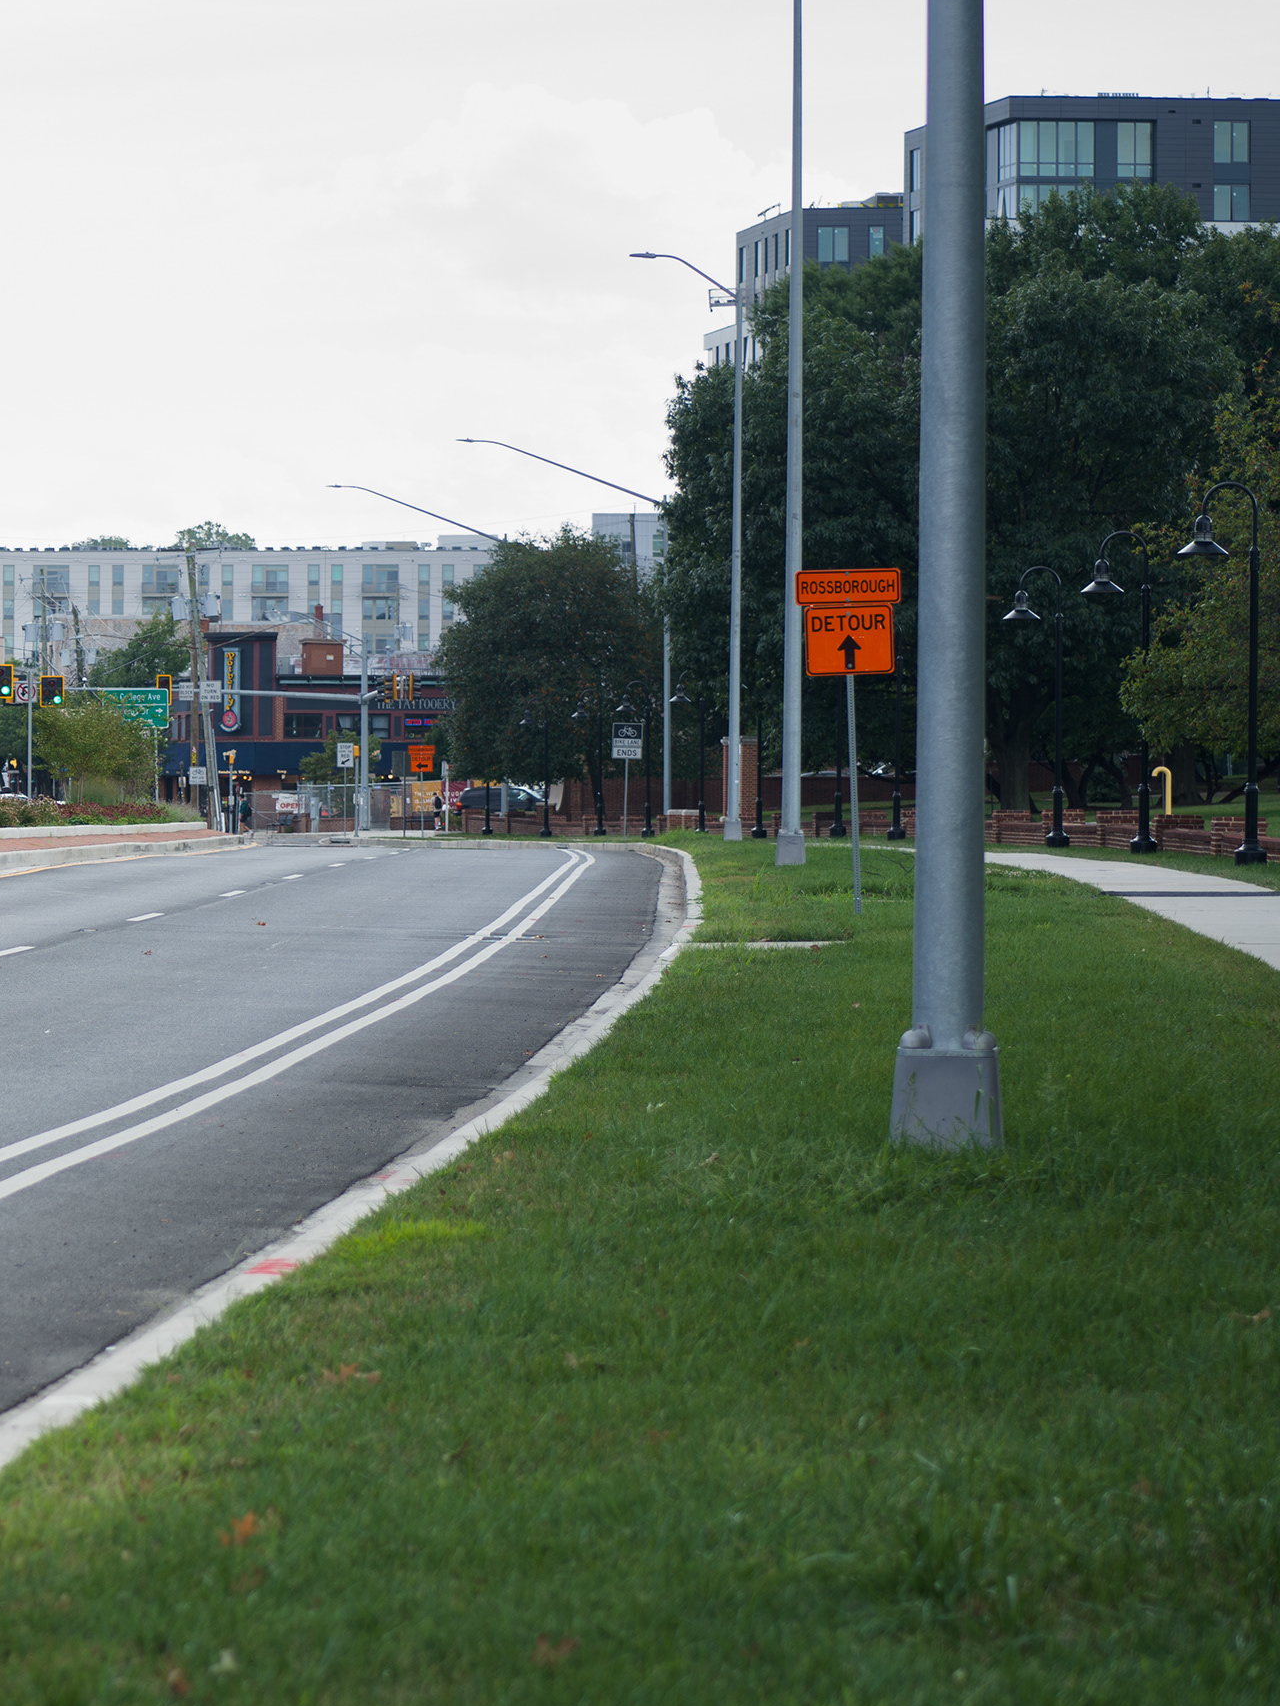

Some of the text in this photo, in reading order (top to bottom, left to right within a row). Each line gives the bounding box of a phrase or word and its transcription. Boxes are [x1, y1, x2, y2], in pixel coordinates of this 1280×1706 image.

[801, 579, 895, 594] ROSSBOROUGH
[811, 614, 886, 632] DETOUR
[147, 693, 161, 701] Ave
